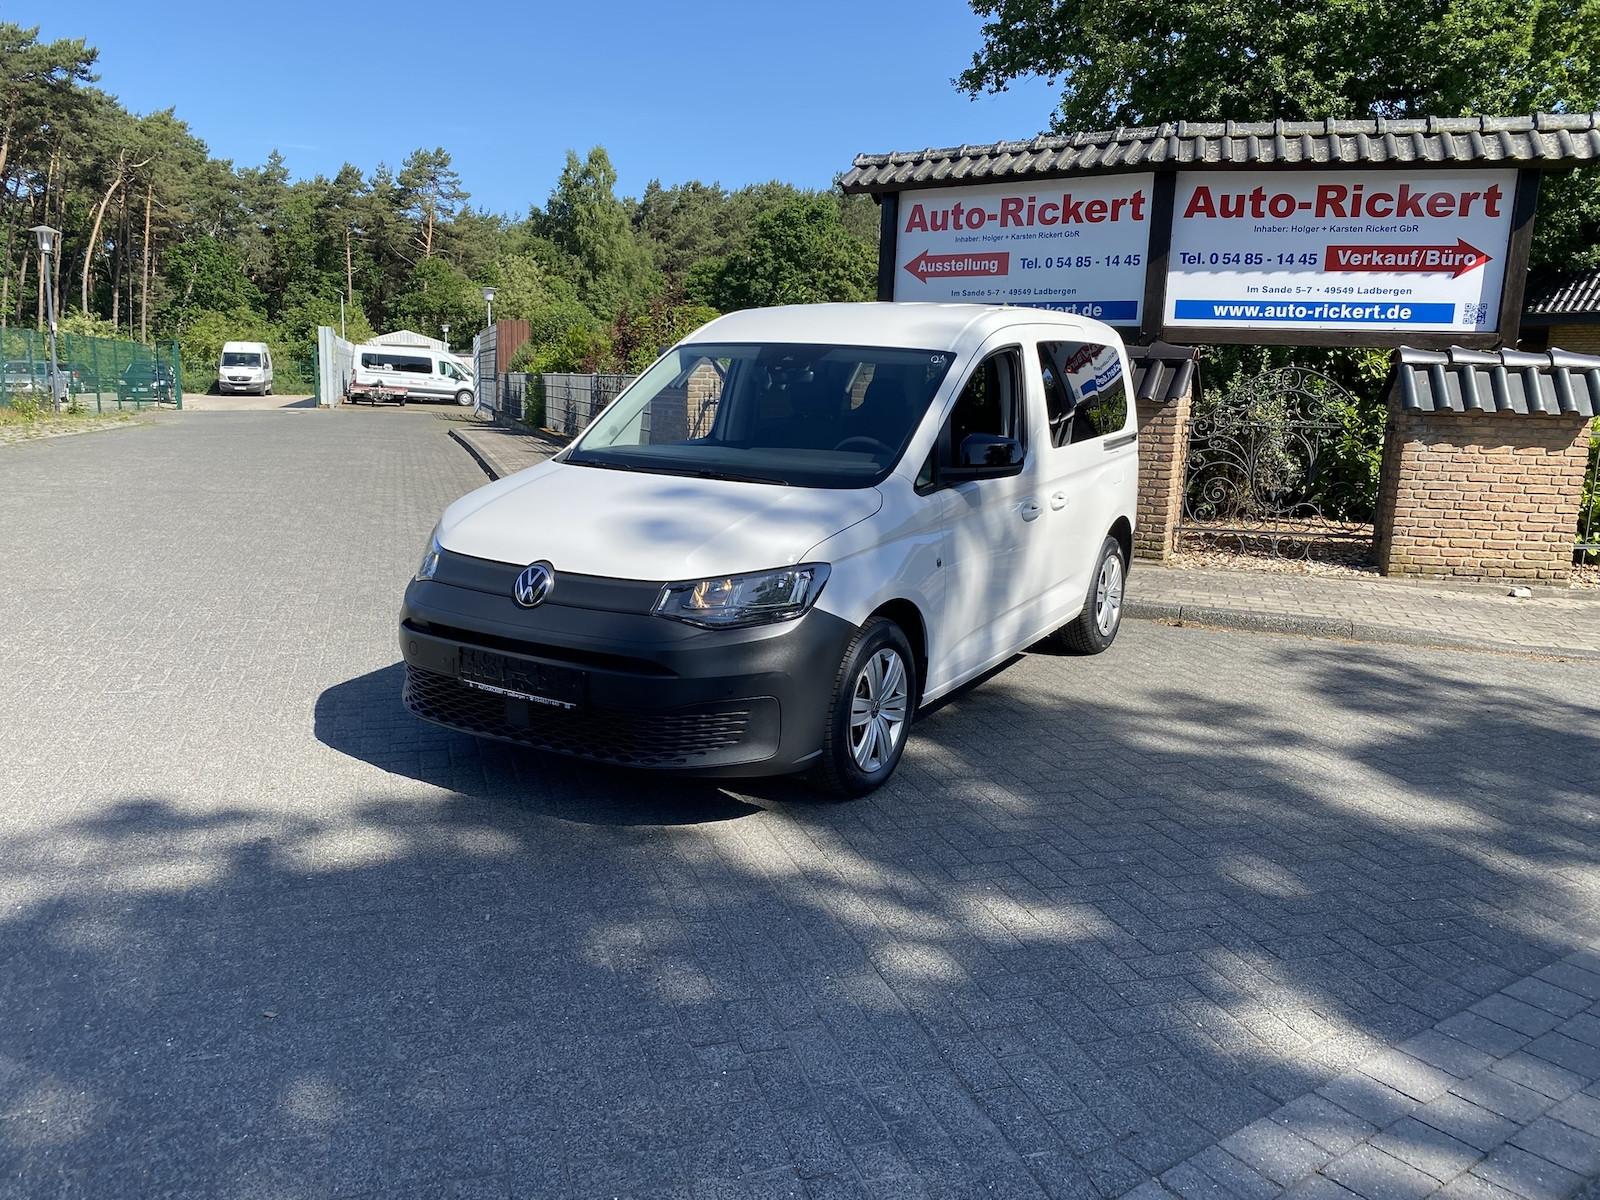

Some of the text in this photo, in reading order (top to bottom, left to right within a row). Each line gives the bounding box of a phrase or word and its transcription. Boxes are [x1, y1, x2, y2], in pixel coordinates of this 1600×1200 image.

[1183, 183, 1502, 219] Auto-Rickert
[905, 190, 1145, 233] Auto-Rickert
[982, 233, 1004, 243] Holger
[1011, 232, 1037, 241] Karsten
[1038, 231, 1063, 239] Rickert
[1064, 230, 1080, 238] GbR
[1254, 225, 1288, 233] Inhaber:
[1291, 225, 1319, 234] Holger
[1329, 225, 1363, 233] Karsten
[1365, 225, 1397, 233] Rickert
[1399, 225, 1419, 233] GbR
[918, 258, 999, 273] Ausstellung
[1020, 257, 1042, 270] Tel.
[1045, 257, 1053, 269] 0
[1056, 256, 1072, 268] 54
[1075, 256, 1092, 268] 85
[1105, 255, 1120, 267] 14
[1123, 254, 1141, 266] 45
[1180, 252, 1206, 265] Tel.
[1209, 252, 1219, 265] 0
[1222, 252, 1241, 265] 54
[1244, 252, 1263, 265] 85
[1276, 253, 1295, 265] 14
[1298, 253, 1318, 265] 45
[1337, 249, 1477, 268] Verkauf/Büro
[962, 289, 985, 297] Sande
[1008, 288, 1032, 296] 49549
[1033, 287, 1077, 297] Ladbergen
[1247, 286, 1259, 294] Im
[1262, 286, 1292, 294] Sande
[1324, 286, 1354, 295] 49549
[1357, 287, 1412, 297] Ladbergen
[1213, 304, 1412, 319] www.auto-rickert.de
